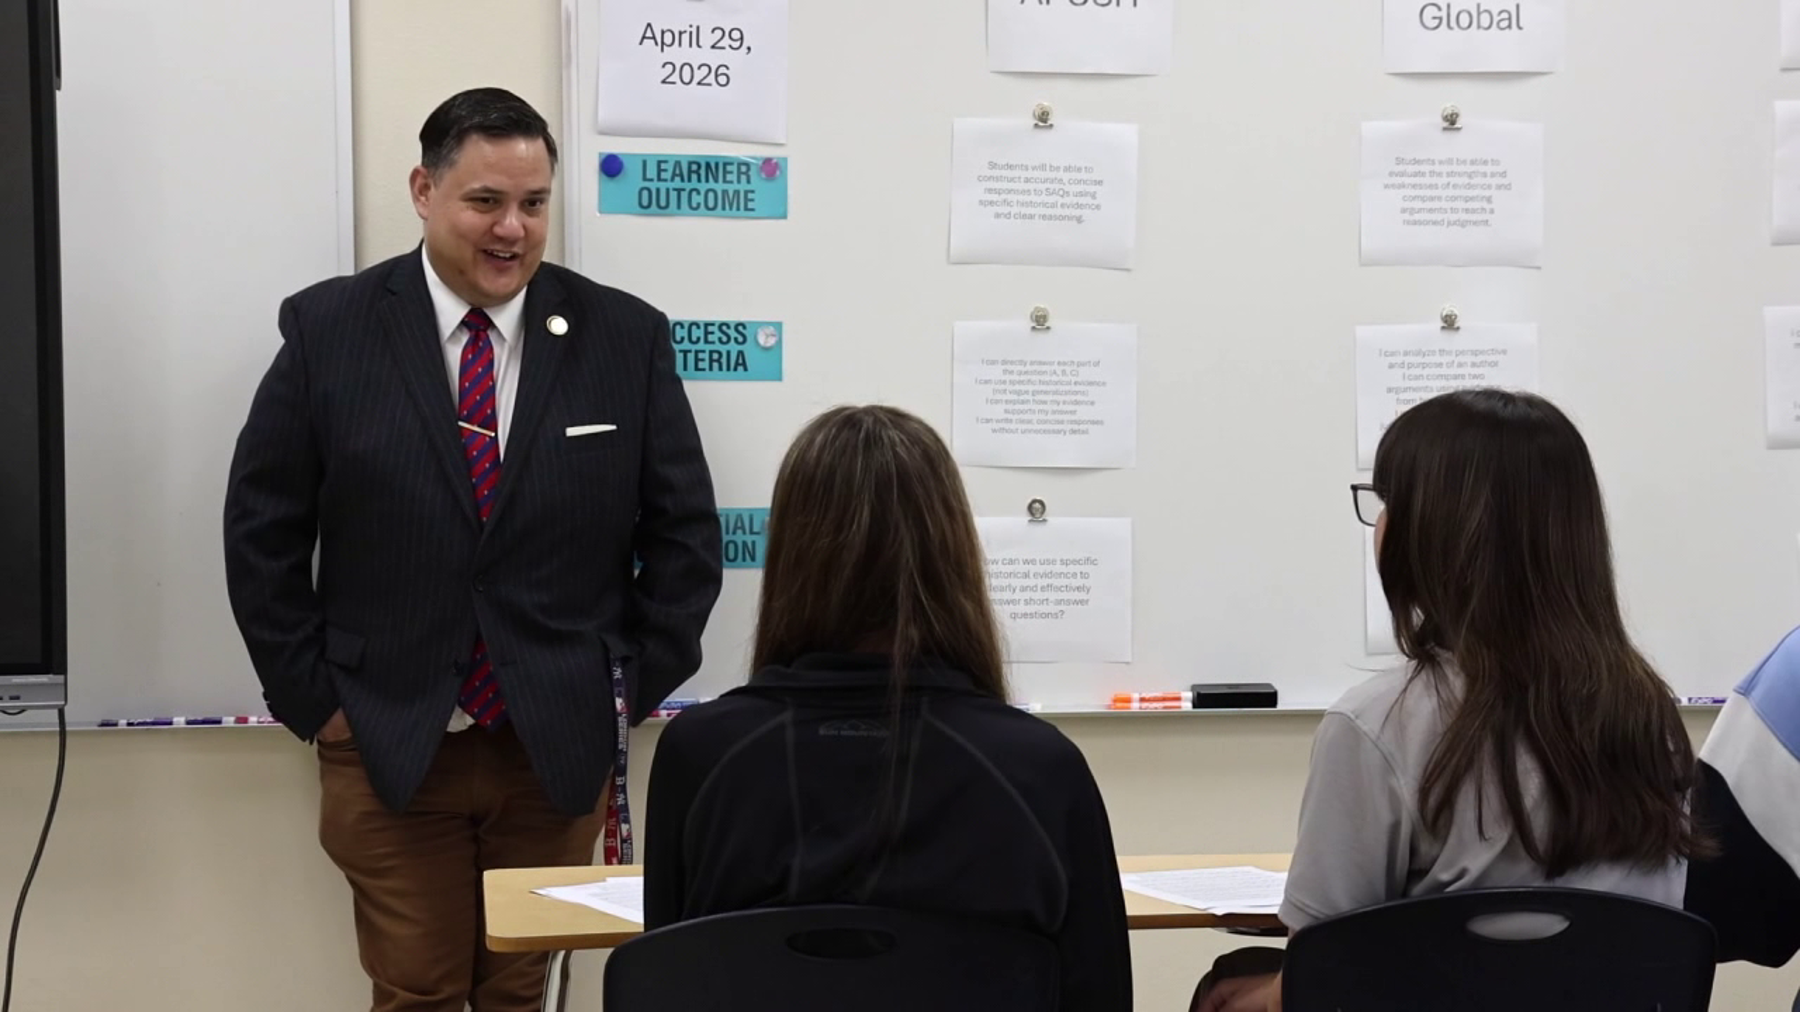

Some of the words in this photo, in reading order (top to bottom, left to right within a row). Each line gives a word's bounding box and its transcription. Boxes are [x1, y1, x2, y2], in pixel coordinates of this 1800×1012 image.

[1419, 3, 1523, 31] Global
[639, 22, 702, 52] April
[710, 27, 751, 54] 29,
[660, 62, 730, 87] 2026
[1395, 157, 1436, 166] Students
[1438, 157, 1454, 166] will
[1456, 157, 1468, 166] be
[1470, 157, 1489, 166] able
[1491, 157, 1500, 166] to
[642, 159, 751, 184] LEARNER
[988, 162, 1029, 172] Students
[1031, 163, 1047, 173] will
[1049, 163, 1060, 173] be
[1063, 164, 1082, 173] able
[1084, 164, 1093, 174] to
[1389, 169, 1426, 178] evaluate
[1429, 169, 1443, 178] the
[1446, 169, 1487, 178] strengths
[1489, 169, 1506, 178] and
[977, 175, 1021, 184] construct
[1068, 177, 1103, 186] concise
[1383, 181, 1438, 190] weaknesses
[1441, 181, 1450, 190] of
[1452, 181, 1492, 190] evidence
[1495, 181, 1511, 190] and
[984, 188, 1031, 197] responses
[1034, 188, 1042, 198] to
[1045, 189, 1070, 198] SAQs
[1073, 190, 1096, 199] using
[1402, 193, 1442, 203] compare
[1445, 193, 1492, 203] competing
[638, 187, 755, 211] OUTCOME
[978, 199, 1014, 209] specific
[1016, 200, 1058, 210] historical
[1060, 201, 1101, 211] evidence
[1400, 206, 1447, 215] arguments
[1449, 206, 1459, 215] to
[1461, 206, 1487, 215] reach
[1489, 206, 1494, 215] a
[994, 211, 1011, 221] and
[1013, 212, 1036, 221] clear
[1038, 213, 1084, 222] reasoning.
[1403, 218, 1444, 228] reasoned
[672, 322, 747, 344] CCESS
[1384, 349, 1401, 357] can
[1403, 349, 1436, 357] analyze
[1439, 349, 1452, 357] the
[1455, 349, 1507, 357] perspective
[678, 350, 748, 372] TERIA
[1001, 359, 1027, 367] directly
[1093, 360, 1100, 368] of
[1388, 361, 1405, 369] and
[1407, 361, 1443, 369] purpose
[1446, 361, 1454, 369] of
[1457, 361, 1468, 369] an
[1408, 373, 1424, 381] can
[1426, 373, 1465, 381] compare
[1468, 373, 1484, 381] two
[1021, 428, 1067, 436] unnecessary
[984, 556, 1000, 567] ow
[1002, 556, 1020, 567] can
[1023, 556, 1037, 567] we
[1040, 556, 1057, 567] use
[1060, 556, 1098, 567] specific
[1033, 570, 1077, 580] evidence
[1080, 570, 1090, 580] to
[990, 584, 1017, 593] learly
[1019, 584, 1037, 593] and
[1041, 584, 1091, 593] effectively
[992, 598, 1021, 606] nswer
[1024, 598, 1089, 606] short-answer
[1010, 611, 1064, 620] questions?
